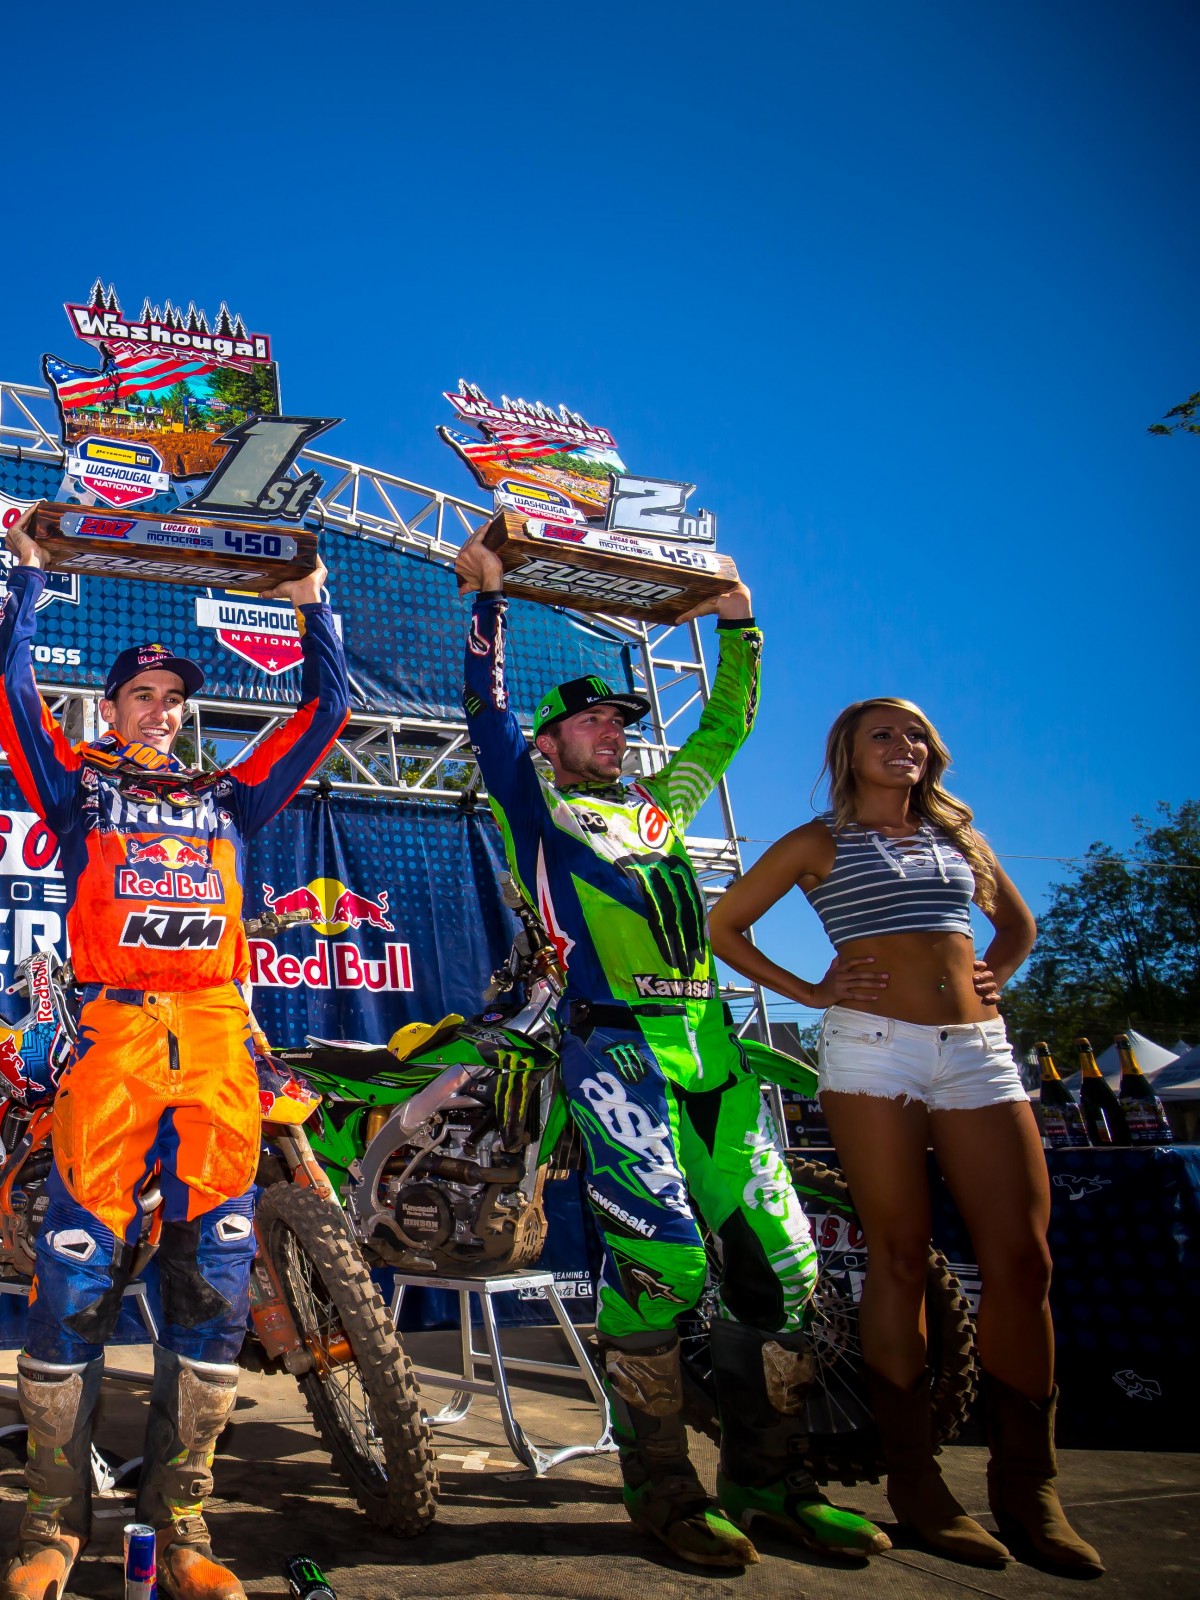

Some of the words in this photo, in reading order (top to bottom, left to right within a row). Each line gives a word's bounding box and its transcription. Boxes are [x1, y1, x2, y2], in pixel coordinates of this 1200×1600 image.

[72, 308, 267, 358] Washougal
[452, 396, 612, 444] Washougal
[136, 454, 151, 464] CAT
[202, 421, 314, 513] 1st
[86, 464, 152, 484] WASHOUGAL
[93, 479, 144, 494] NATIONAL
[514, 497, 570, 516] WASHOUGAL
[614, 476, 714, 538] 2nd
[79, 518, 134, 538] 2017
[163, 524, 186, 533] LUCAS
[189, 526, 199, 534] OIL
[147, 533, 213, 547] MOTOCROSS
[224, 531, 282, 557] 450
[599, 540, 654, 557] MOTOCROSS
[609, 535, 628, 545] LUCAS
[659, 545, 707, 569] 450
[232, 634, 301, 647] NATIONA
[120, 870, 173, 897] Red
[177, 870, 221, 899] Bull
[121, 907, 225, 949] KTM
[31, 960, 49, 988] Bull
[251, 939, 329, 988] Red
[336, 941, 413, 991] Bull
[33, 987, 53, 1023] Red
[402, 1203, 438, 1214] Kawasaki
